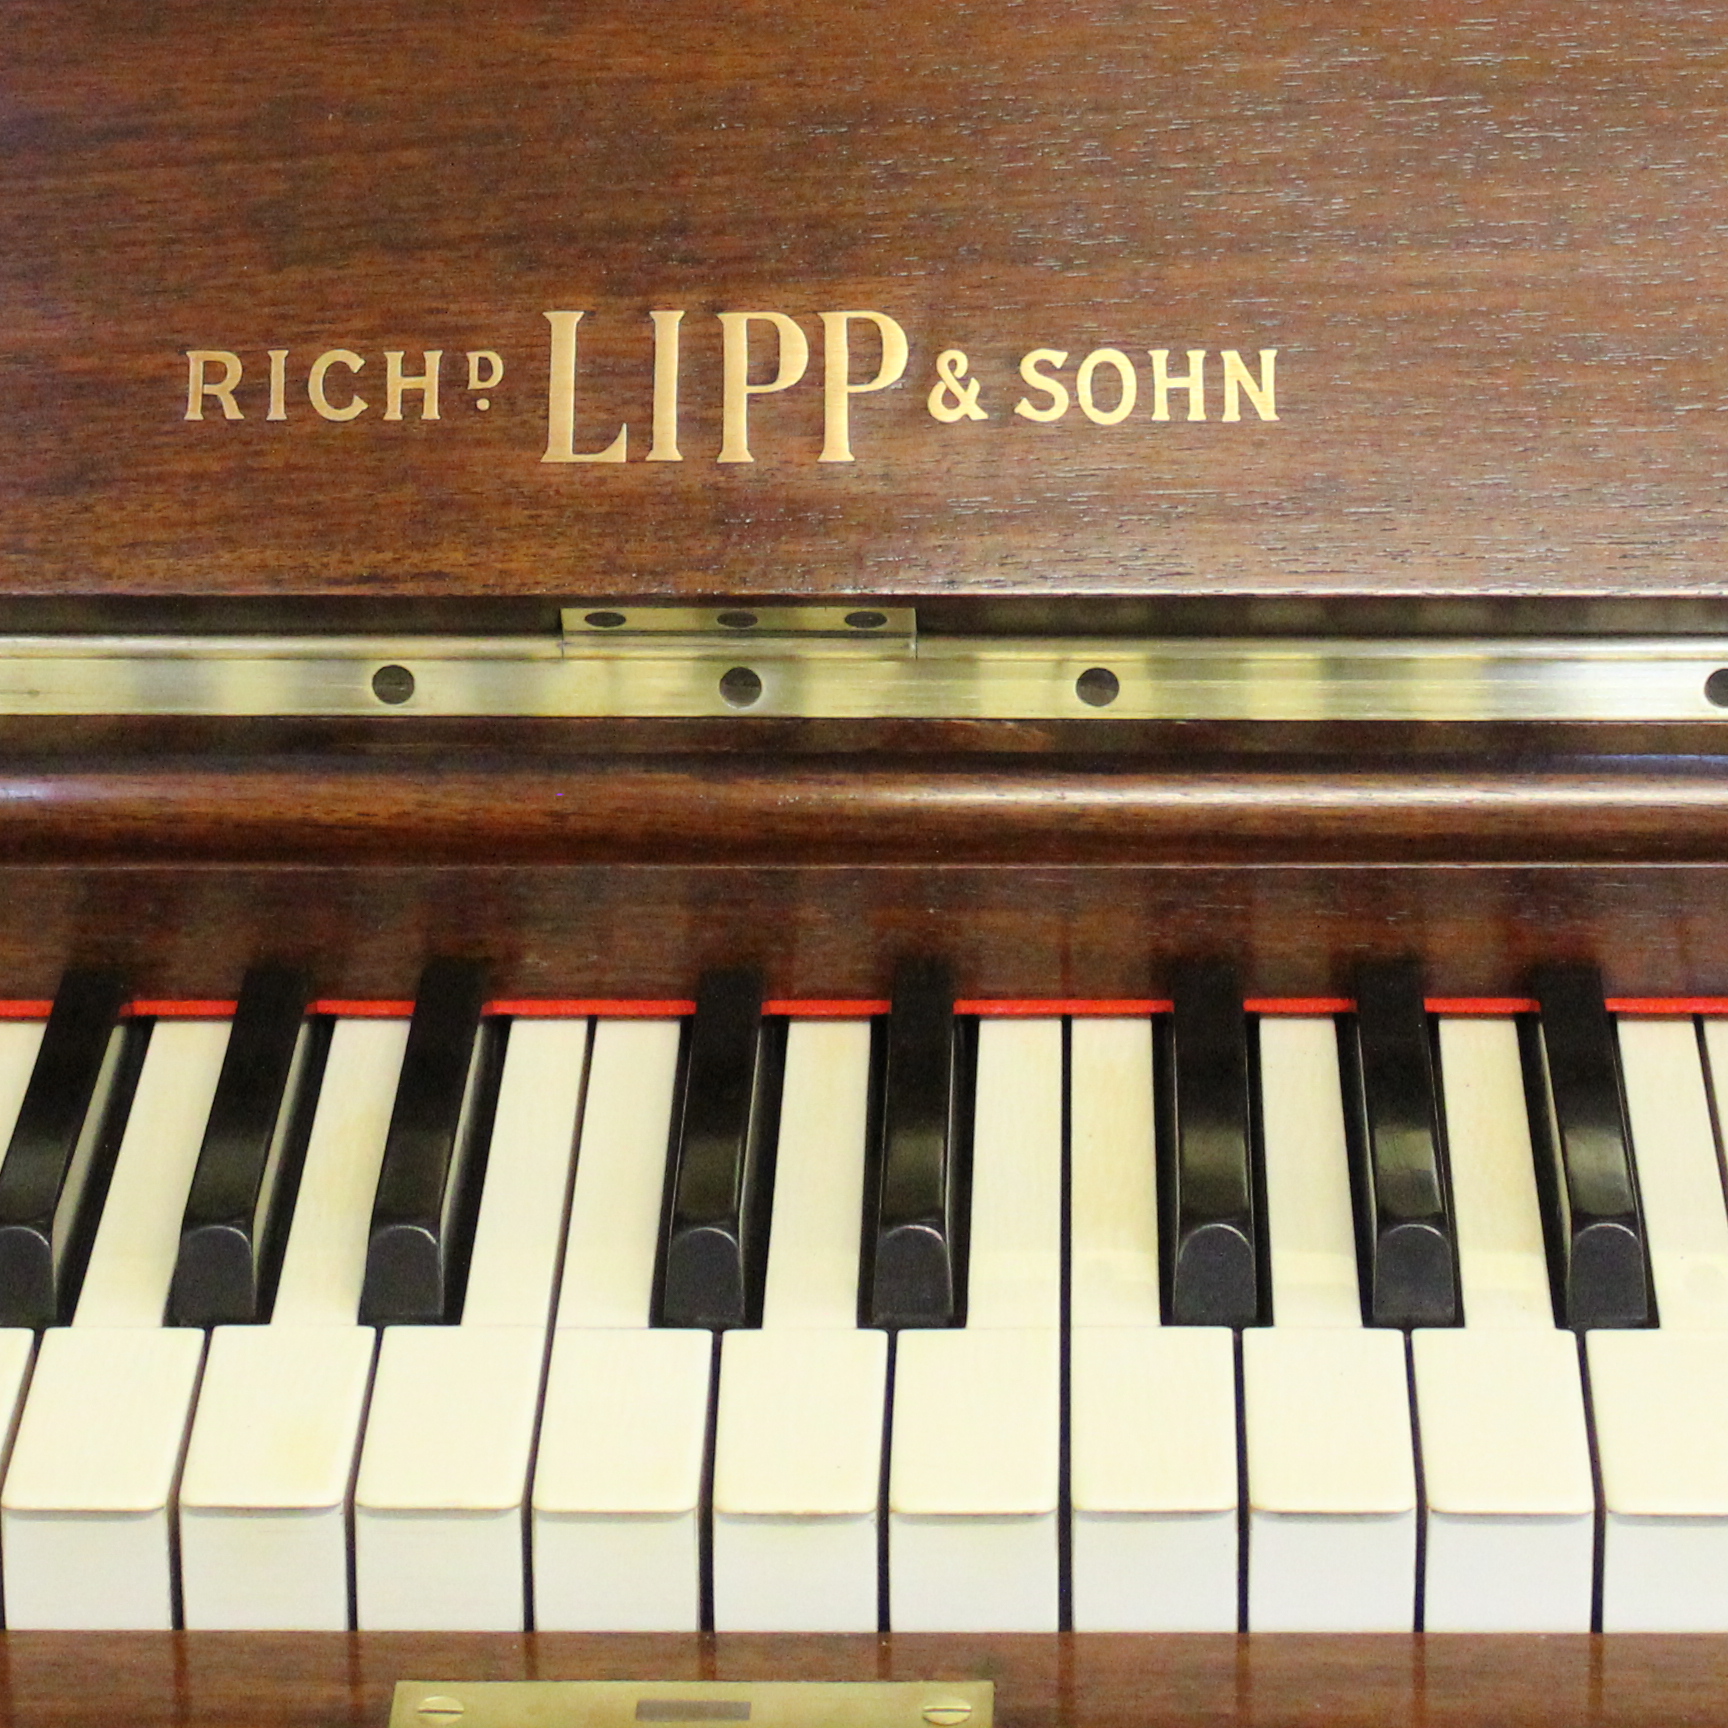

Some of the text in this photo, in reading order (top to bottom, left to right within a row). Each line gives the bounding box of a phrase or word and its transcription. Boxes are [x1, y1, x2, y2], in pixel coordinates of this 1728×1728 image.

[540, 310, 910, 463] LIPP
[927, 348, 983, 421] &
[1015, 347, 1280, 425] SOHN
